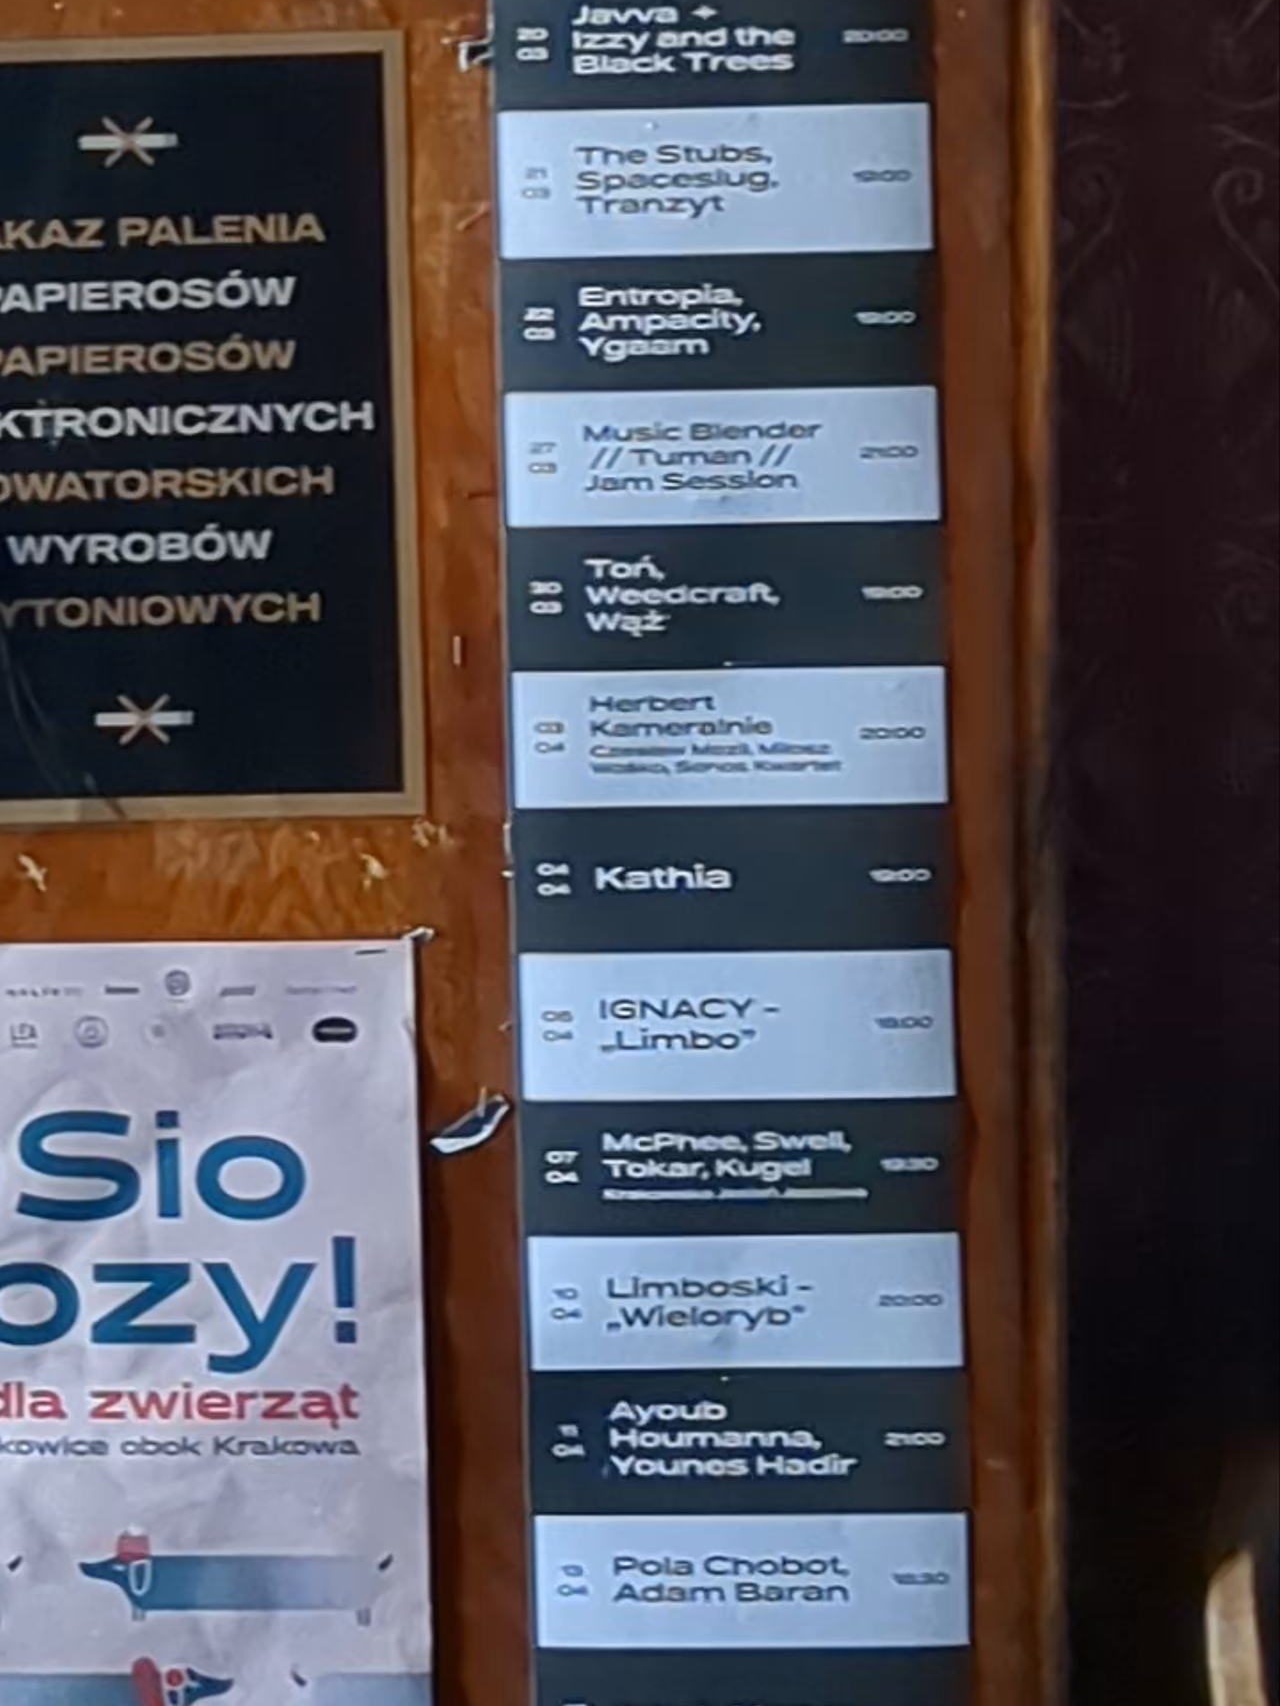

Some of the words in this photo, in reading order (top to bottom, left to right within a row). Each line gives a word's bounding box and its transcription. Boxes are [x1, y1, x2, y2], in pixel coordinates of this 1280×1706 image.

[572, 5, 679, 26] Javva
[572, 29, 648, 54] Izzy
[655, 27, 727, 47] and
[734, 25, 796, 47] the
[572, 53, 676, 75] Black
[682, 51, 794, 72] Trees
[576, 145, 648, 165] The
[656, 143, 774, 166] Stubs,
[576, 194, 726, 220] Tranzyt
[118, 212, 327, 248] PALENIA
[578, 283, 744, 308] Entropia,
[578, 309, 762, 335] Ampacity,
[582, 422, 682, 443] Music
[689, 420, 823, 441] Blender
[629, 448, 752, 468] Tuman
[585, 473, 655, 493] Jam
[661, 470, 799, 491] Session
[6, 523, 274, 566] WYROBÓW
[584, 582, 781, 606] Weedcraft,
[589, 694, 717, 713] Herbert
[589, 715, 775, 738] Kameralnie
[594, 862, 734, 891] Kathia
[599, 998, 756, 1020] IGNACY
[601, 1131, 748, 1154] McPhee,
[601, 1158, 710, 1182] Tokar,
[715, 1157, 813, 1181] Kugel
[605, 1275, 790, 1299] Limboski
[89, 1381, 361, 1430] zwierząt
[608, 1400, 729, 1426] Ayoub
[120, 1435, 203, 1457] obok
[212, 1435, 362, 1457] Krakowa
[609, 1427, 823, 1451] Houmanna,
[609, 1454, 749, 1477] Younes
[756, 1452, 859, 1476] Hadir
[612, 1555, 695, 1577] Pola
[703, 1554, 851, 1578] Chobot,
[612, 1582, 726, 1604] Adam
[734, 1582, 851, 1603] Baran
